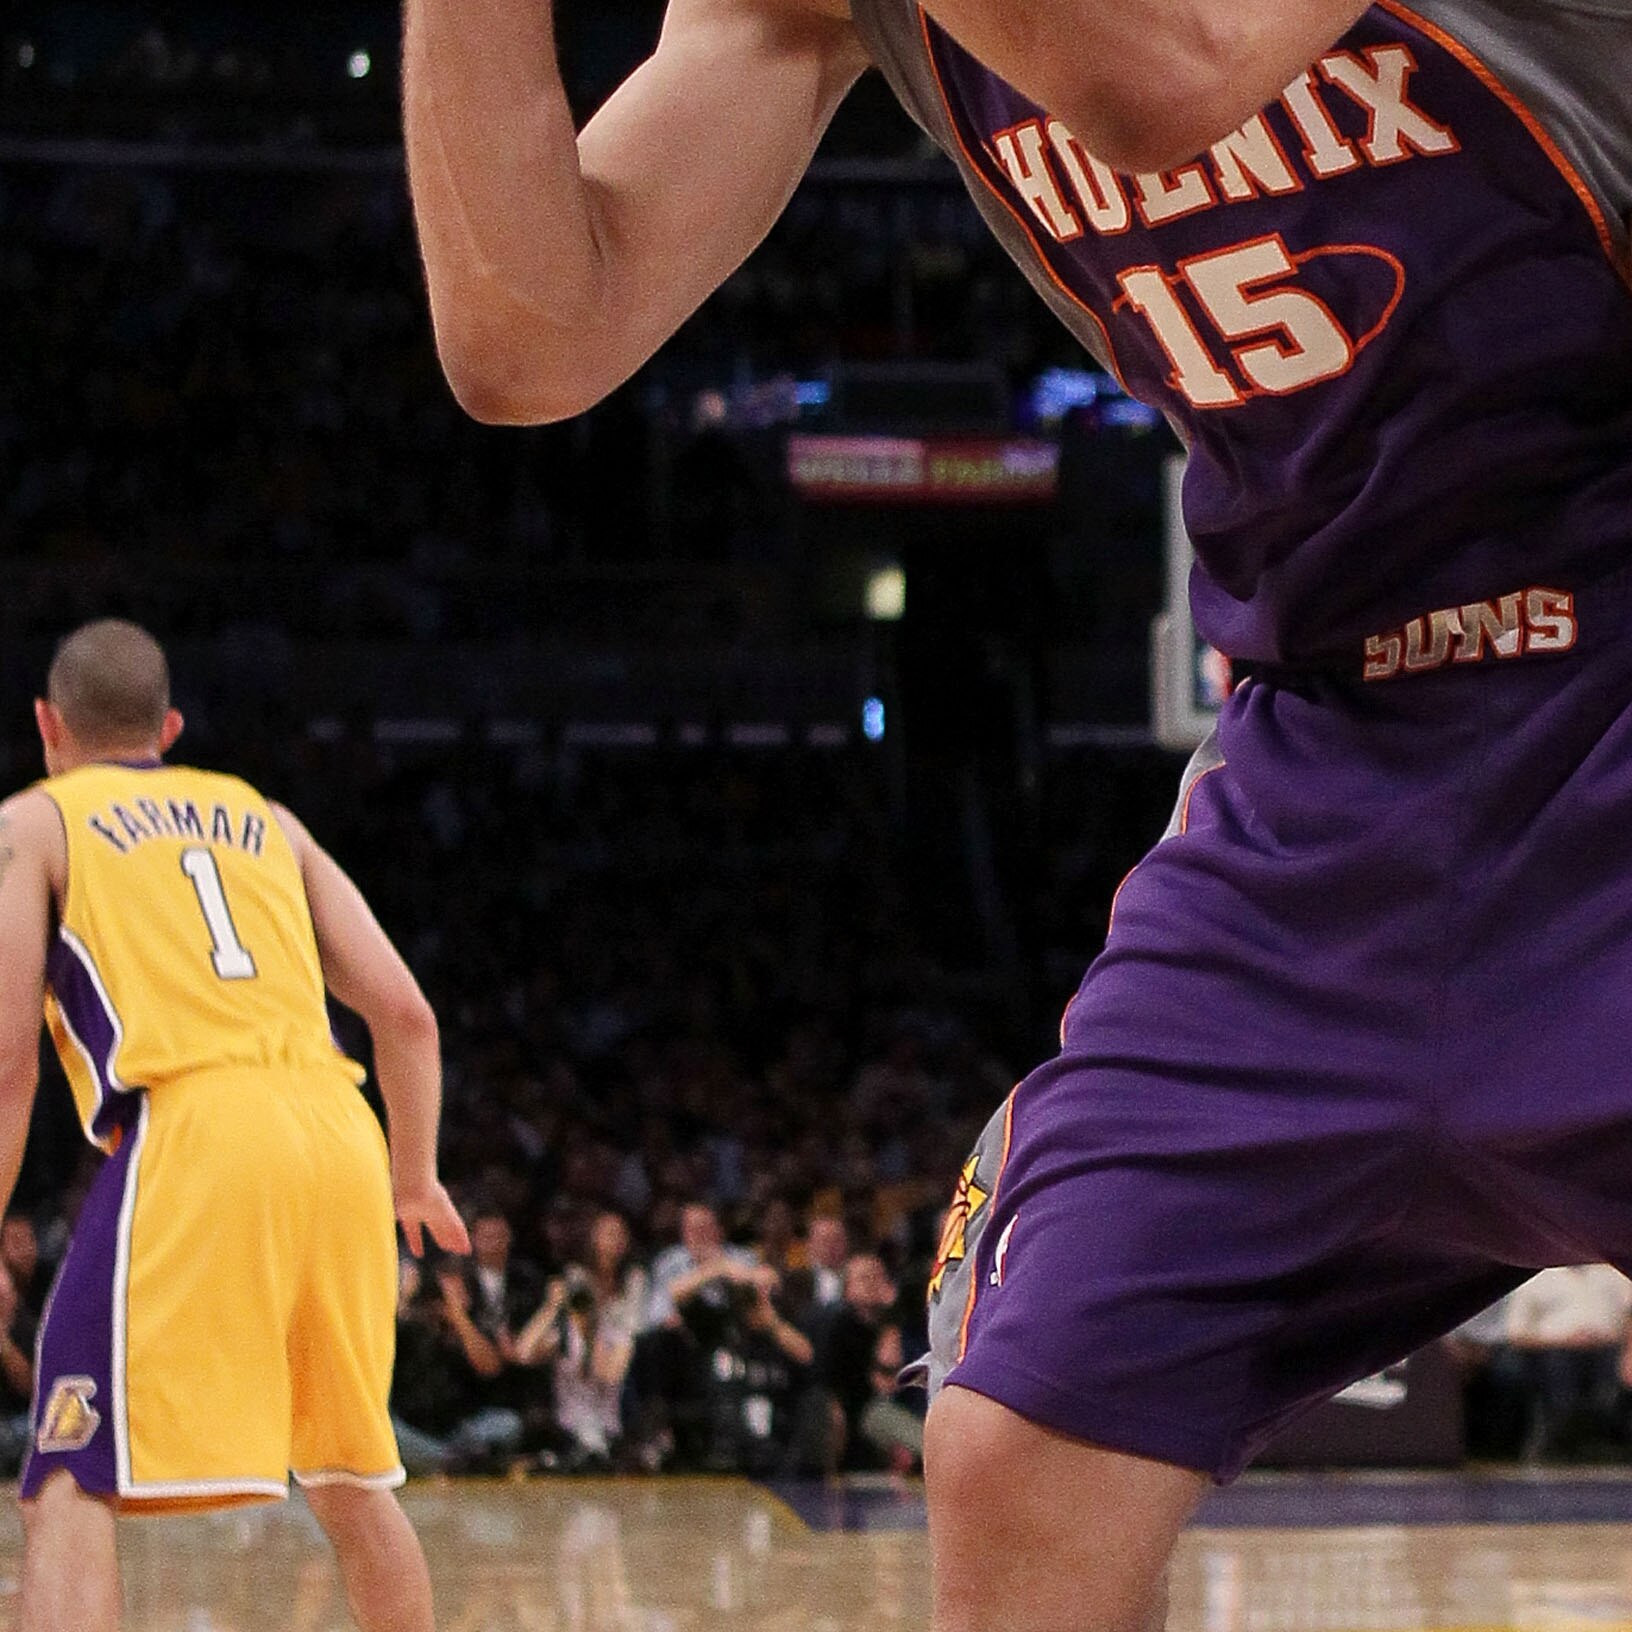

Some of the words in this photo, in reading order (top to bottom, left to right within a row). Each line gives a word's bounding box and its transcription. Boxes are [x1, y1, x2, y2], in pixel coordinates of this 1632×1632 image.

[984, 42, 1462, 241] HOENIX
[1114, 232, 1356, 408] 15
[1362, 584, 1579, 683] SUNS
[180, 846, 259, 981] 1
